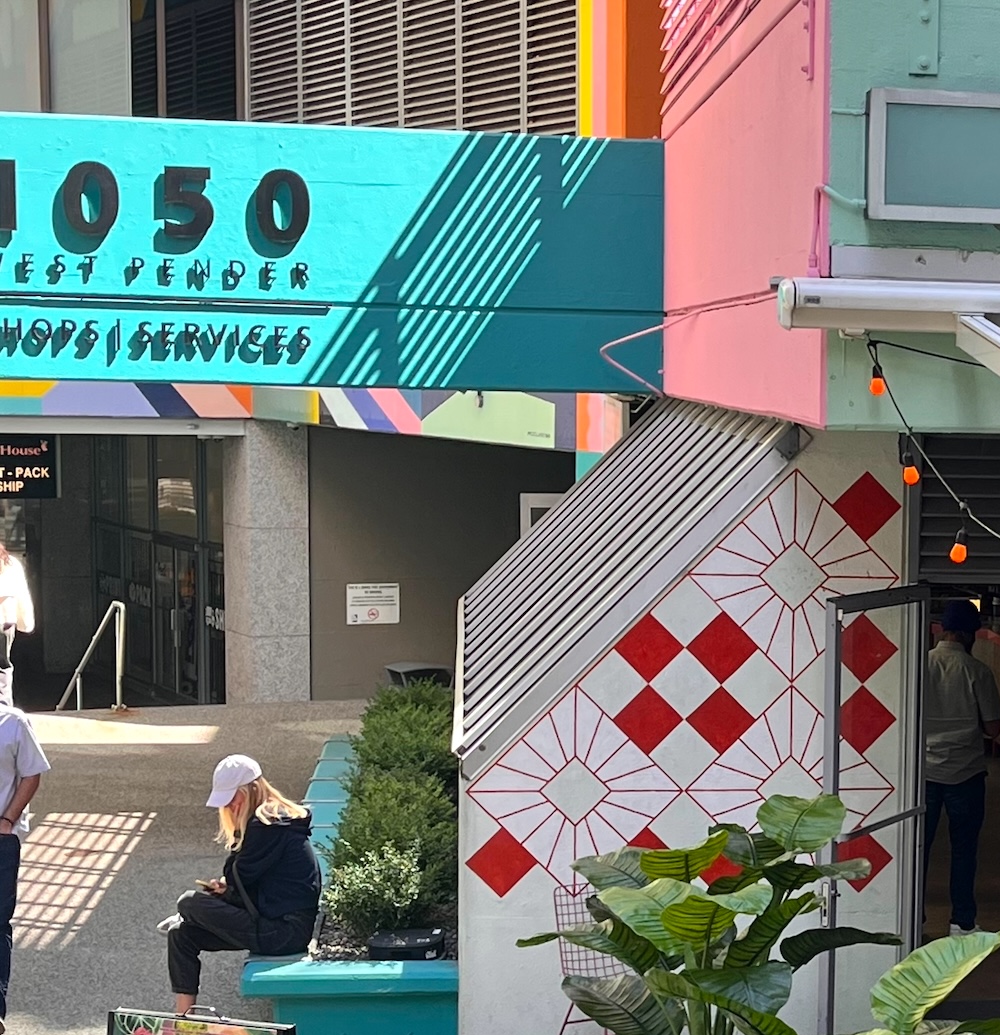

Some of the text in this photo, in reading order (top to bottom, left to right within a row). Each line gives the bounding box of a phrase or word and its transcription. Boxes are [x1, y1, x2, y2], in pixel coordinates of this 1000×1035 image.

[0, 159, 310, 244] 1050
[0, 253, 310, 283] EST PENDER
[137, 320, 312, 351] SERVICES
[0, 445, 41, 456] House
[15, 467, 50, 478] PACK
